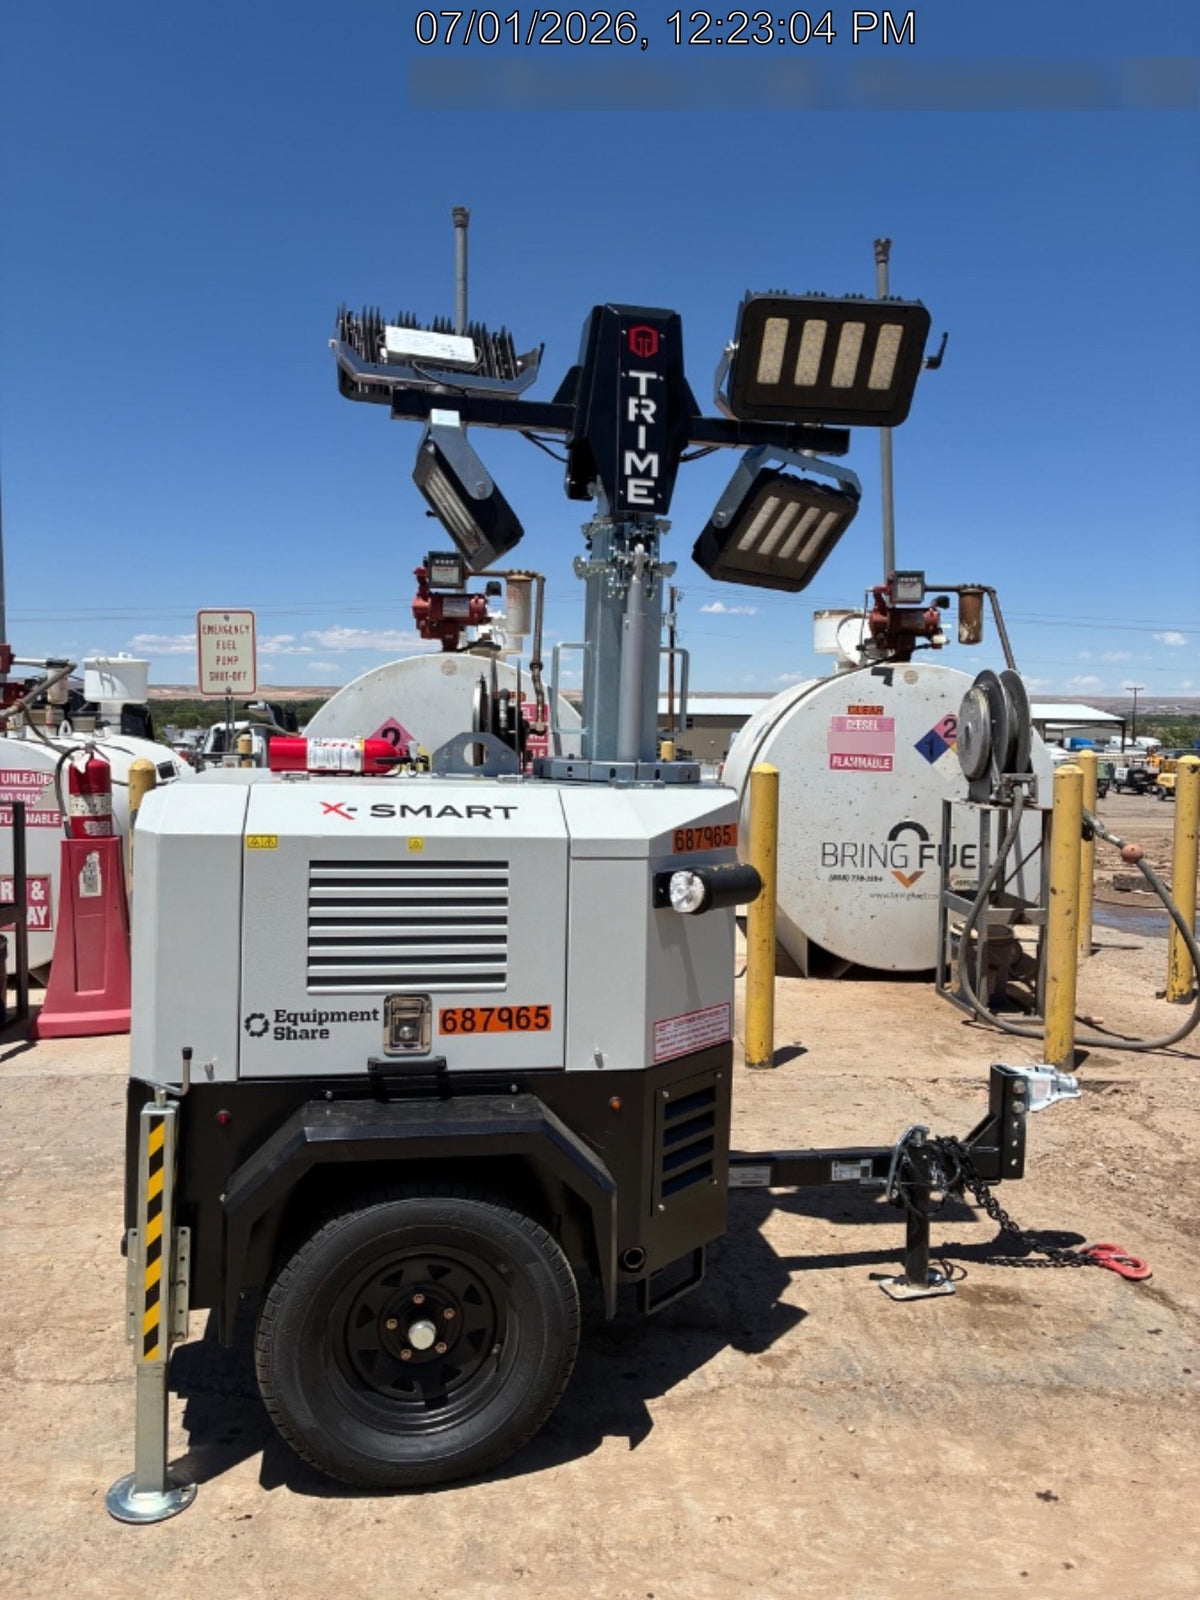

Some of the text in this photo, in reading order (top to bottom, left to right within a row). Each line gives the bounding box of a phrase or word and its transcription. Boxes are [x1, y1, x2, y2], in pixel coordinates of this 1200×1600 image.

[624, 369, 659, 505] TRIME
[202, 624, 250, 635] EMERGENCY
[216, 640, 236, 650] FUEL
[216, 656, 239, 666] PUMP
[943, 717, 958, 738] 2
[675, 825, 732, 851] 687965
[821, 842, 978, 868] BRING FUE
[273, 1008, 380, 1024] Equipment
[441, 1005, 549, 1033] 687965
[273, 1026, 330, 1040] Share
